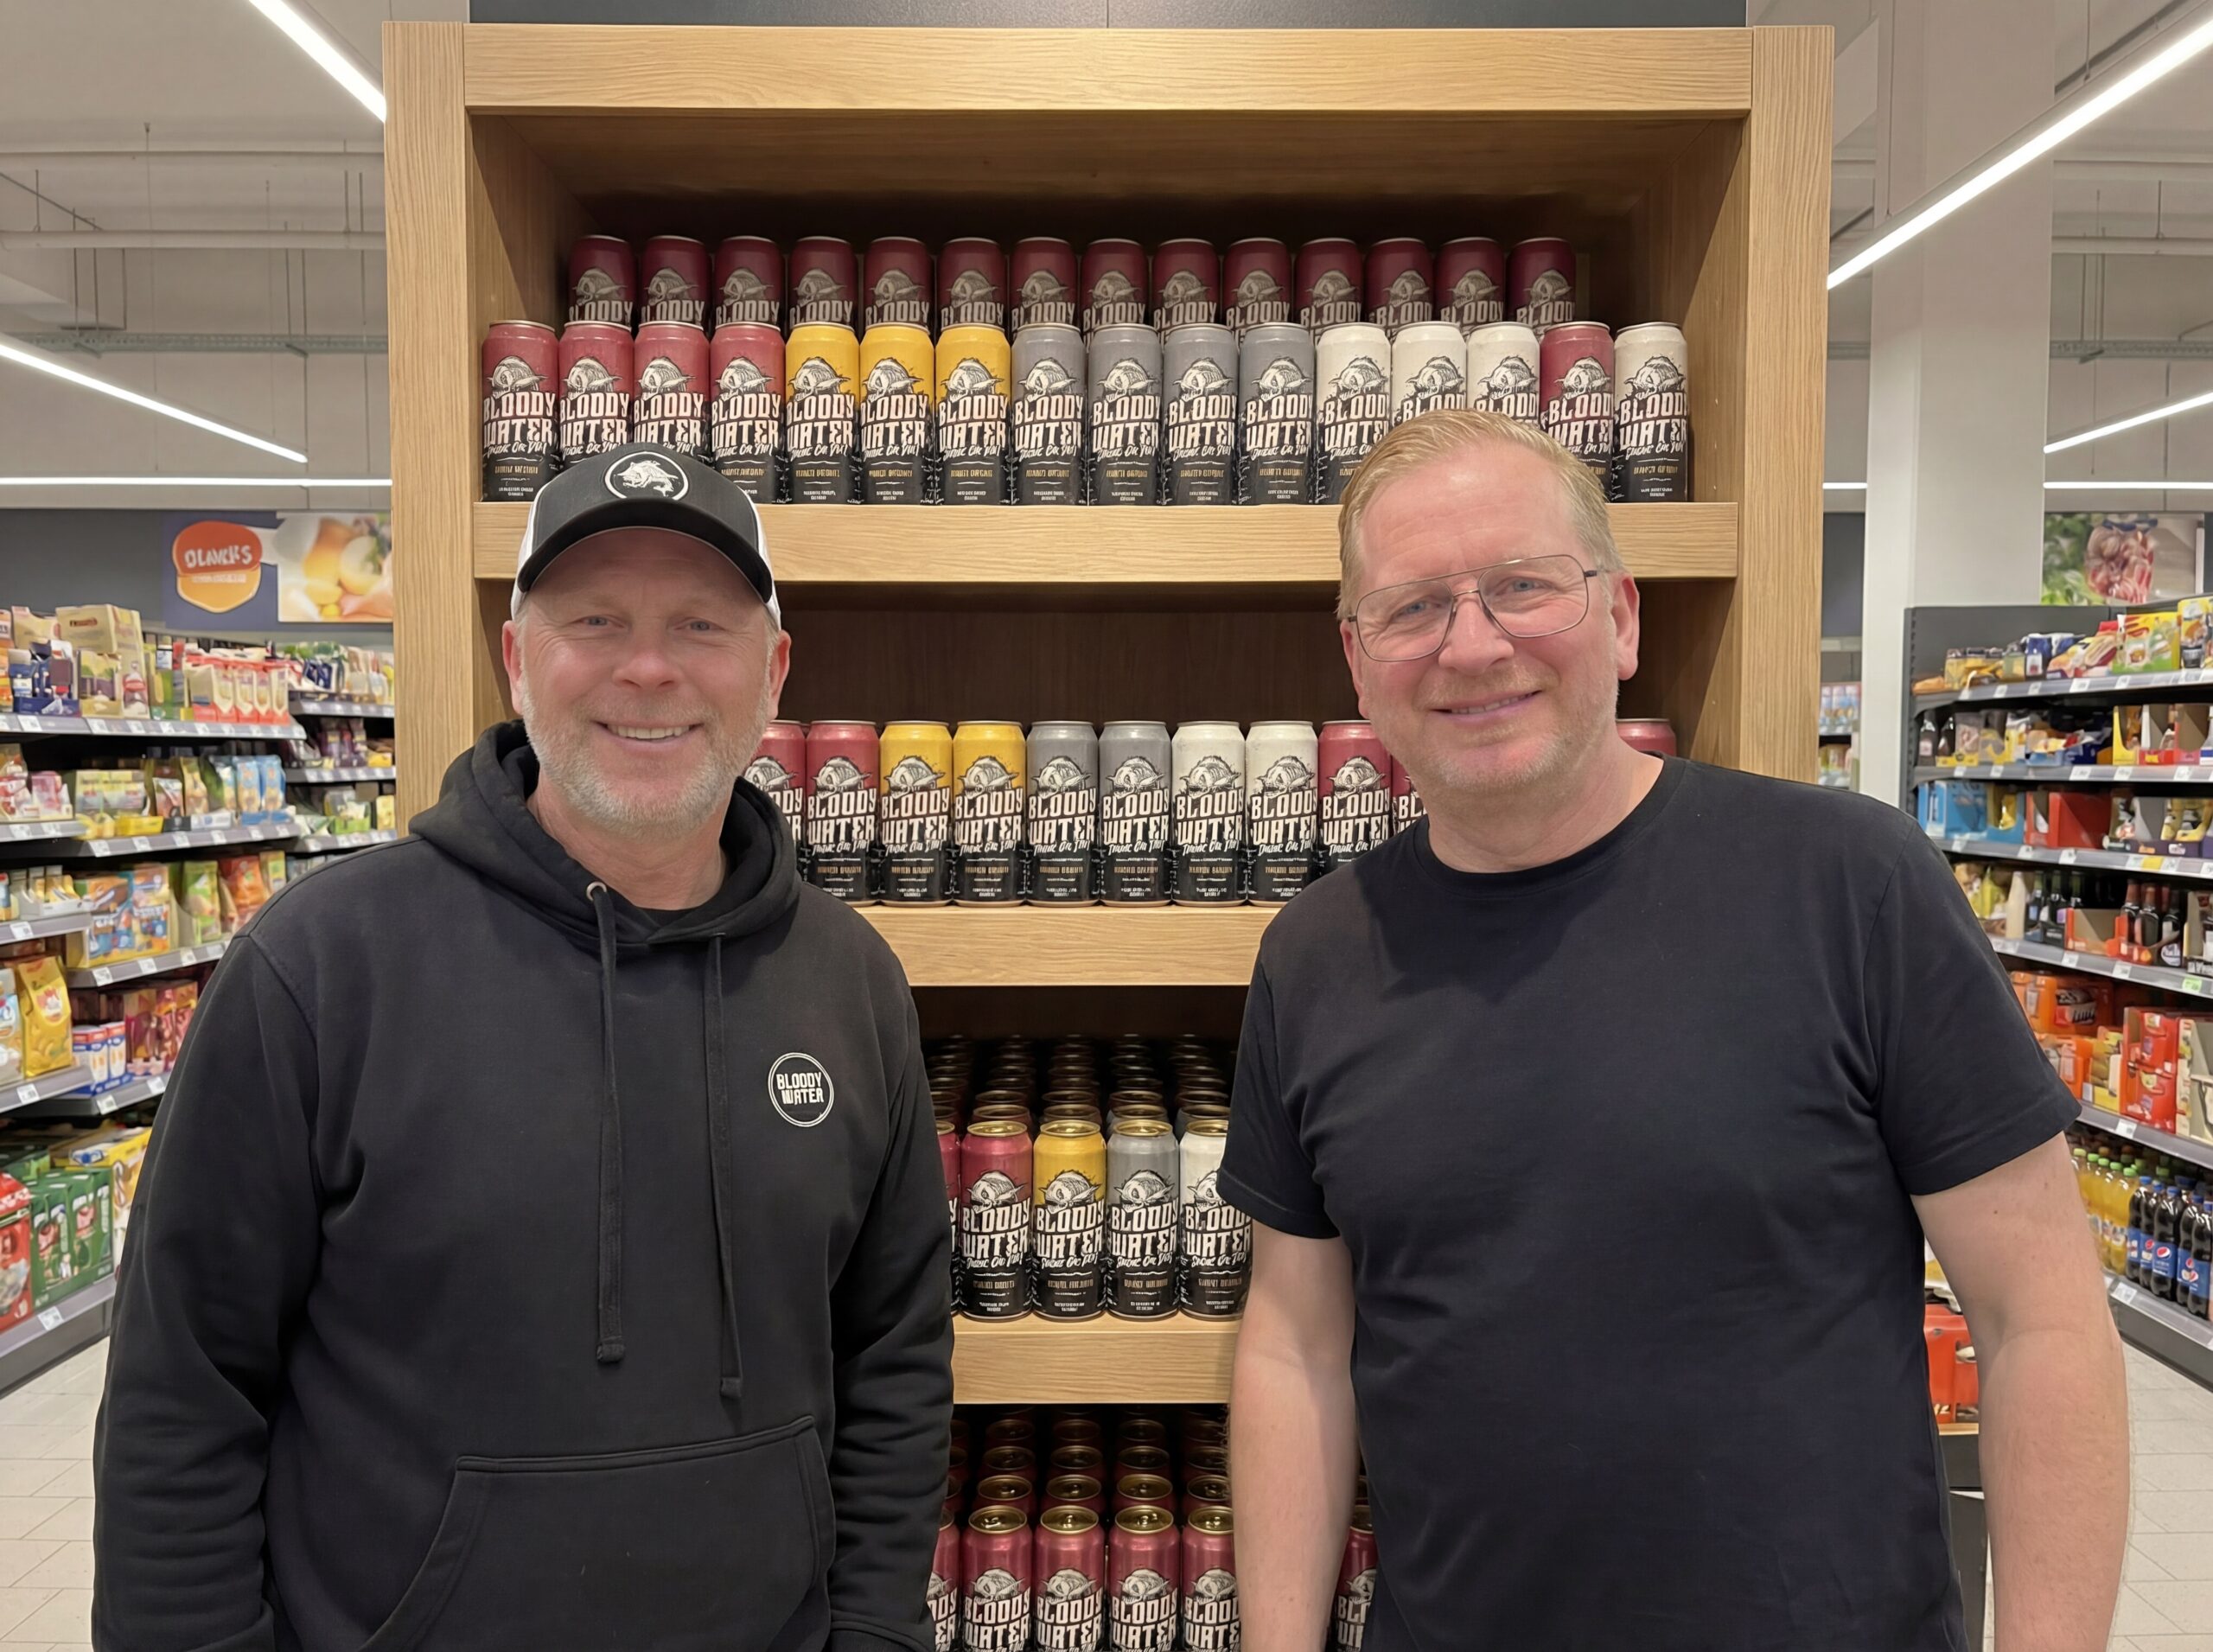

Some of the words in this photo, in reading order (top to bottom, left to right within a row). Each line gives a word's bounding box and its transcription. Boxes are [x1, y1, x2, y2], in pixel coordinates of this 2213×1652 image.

[1083, 302, 1145, 332] BLOODY
[1154, 302, 1216, 330] BLOODY
[1226, 302, 1290, 328] BLOODY
[1376, 302, 1432, 327] BLOOD
[483, 392, 556, 424] BLOODY
[560, 392, 629, 425] BLOODY
[634, 392, 704, 425] BLOODY
[711, 393, 781, 425] BLOODY
[786, 393, 854, 425] BLOODY
[861, 394, 928, 425] BLOODY
[939, 395, 1008, 426] BLOODY
[1015, 395, 1083, 426] BLOODY
[1093, 395, 1160, 426] BLOODY
[1169, 394, 1237, 426] BLOODY
[483, 418, 552, 450] WATER
[560, 419, 627, 450] WATER
[635, 419, 701, 448] WATER
[711, 420, 778, 452] WATER
[787, 420, 852, 452] WATER
[861, 420, 925, 453] WATER
[939, 422, 1006, 453] WATER
[1015, 422, 1081, 453] WATER
[1092, 422, 1159, 453] WATER
[808, 788, 877, 819] BLOODY
[882, 788, 950, 820] BLOODY
[954, 788, 1023, 820] BLOODY
[1029, 788, 1096, 820] BLOODY
[1102, 788, 1169, 820] BLOODY
[1177, 788, 1243, 820] BLOODY
[1252, 788, 1317, 820] BLOODY
[1323, 788, 1390, 820] BLOODY
[808, 814, 875, 845] WATER
[882, 815, 948, 845] WATER
[954, 815, 1021, 845] WATER
[1028, 815, 1094, 845] WATER
[1102, 815, 1168, 845] WATER
[1177, 815, 1242, 845] WATER
[1323, 815, 1389, 845] WATER
[775, 1072, 822, 1090] BLOODY
[781, 1088, 825, 1106] WATER
[963, 1198, 1031, 1233] BLOODY
[1037, 1199, 1104, 1233] BLOODY
[1112, 1197, 1179, 1232] BLOODY
[963, 1225, 1029, 1259] WATER
[1037, 1226, 1102, 1259] WATER
[1112, 1224, 1177, 1259] WATER
[1186, 1224, 1251, 1258] WATER
[965, 1587, 1030, 1624] BLOODY
[1037, 1587, 1103, 1624] BLOODY
[1112, 1588, 1177, 1624] BLOODY
[965, 1613, 1030, 1649] WATER
[1037, 1613, 1102, 1649] WATER
[1113, 1613, 1177, 1649] WATER
[1185, 1621, 1240, 1649] WATE
